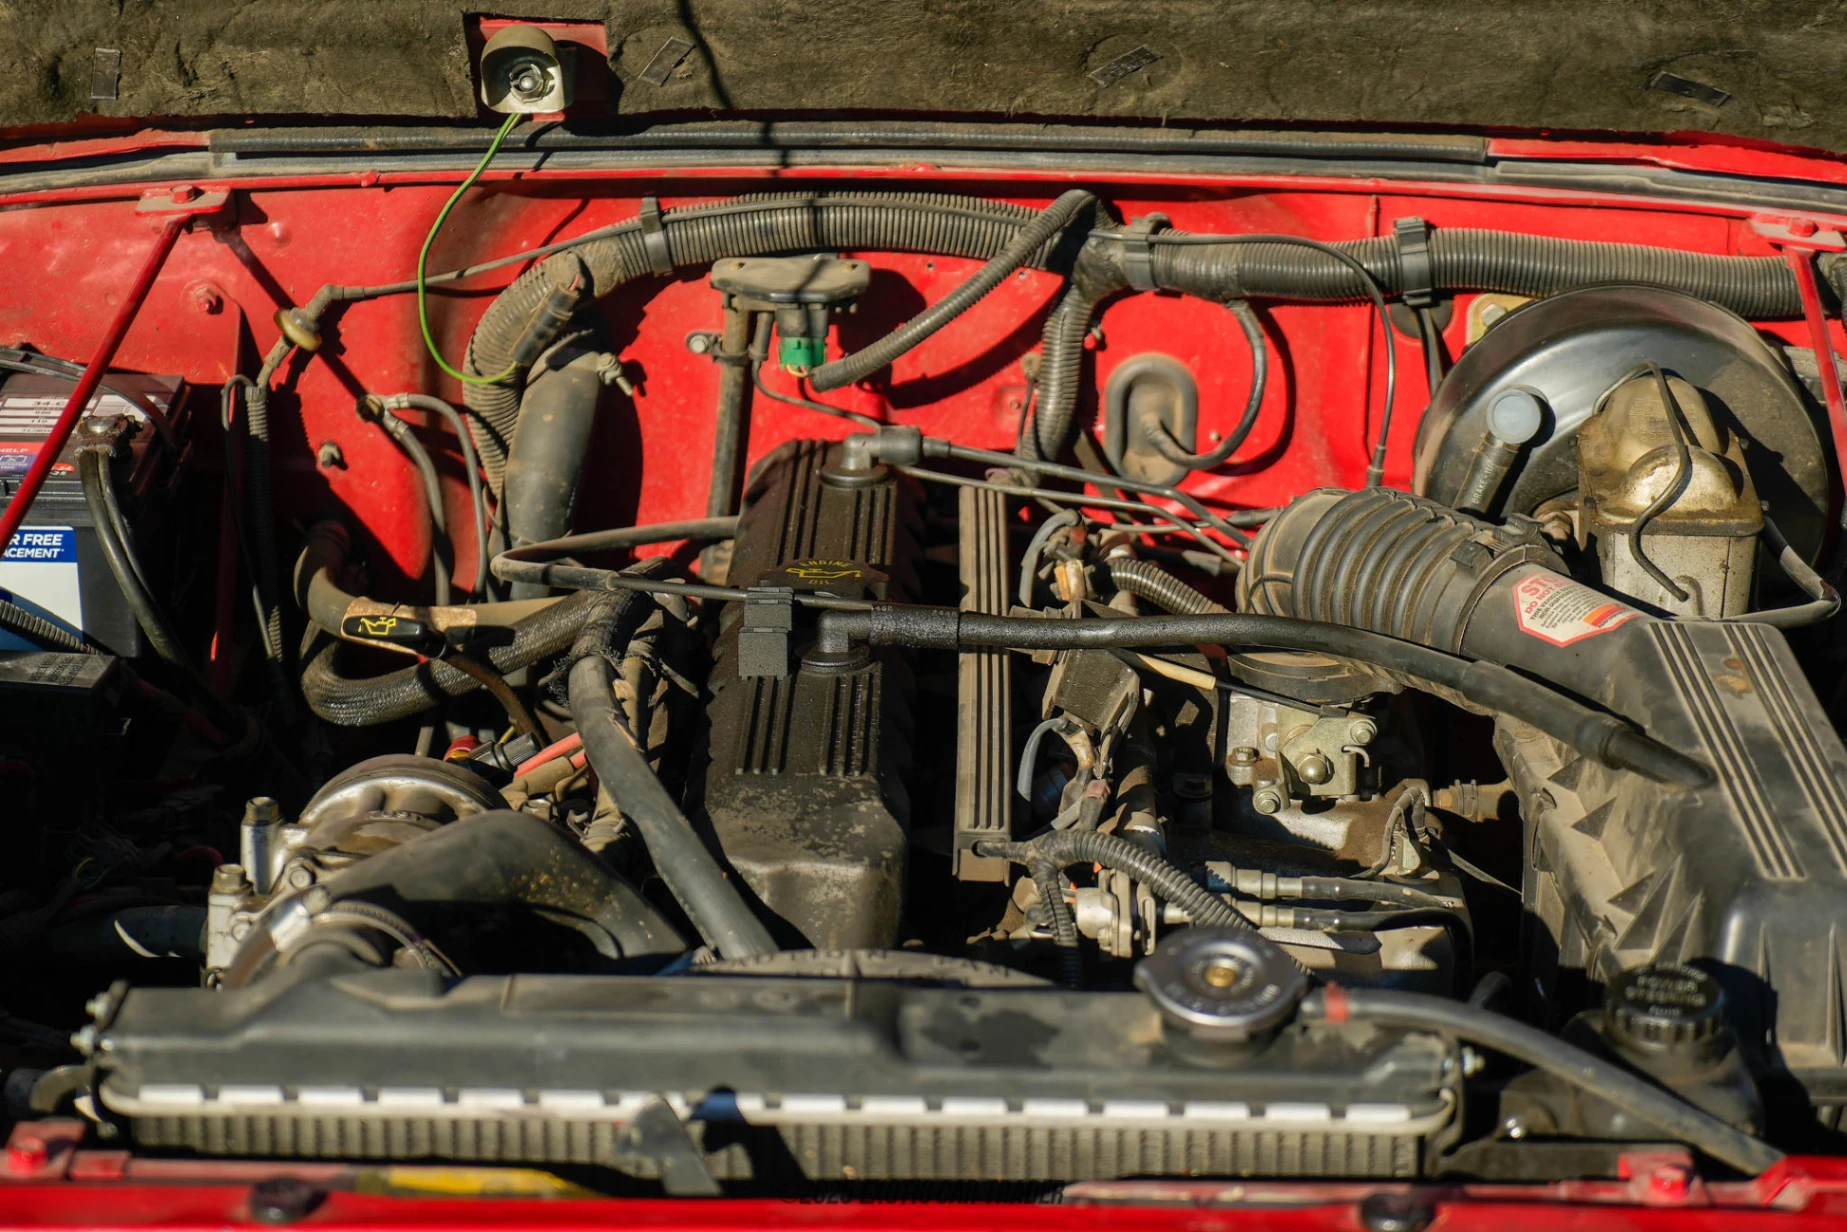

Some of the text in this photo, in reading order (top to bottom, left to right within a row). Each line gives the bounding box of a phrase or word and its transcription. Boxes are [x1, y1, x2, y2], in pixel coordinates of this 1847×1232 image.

[22, 533, 63, 546] FREE
[798, 560, 853, 568] ENGINE
[1524, 600, 1538, 614] DO
[1536, 585, 1556, 601] NOT
[1637, 975, 1698, 993] POWER
[1625, 985, 1707, 1007] STEERING
